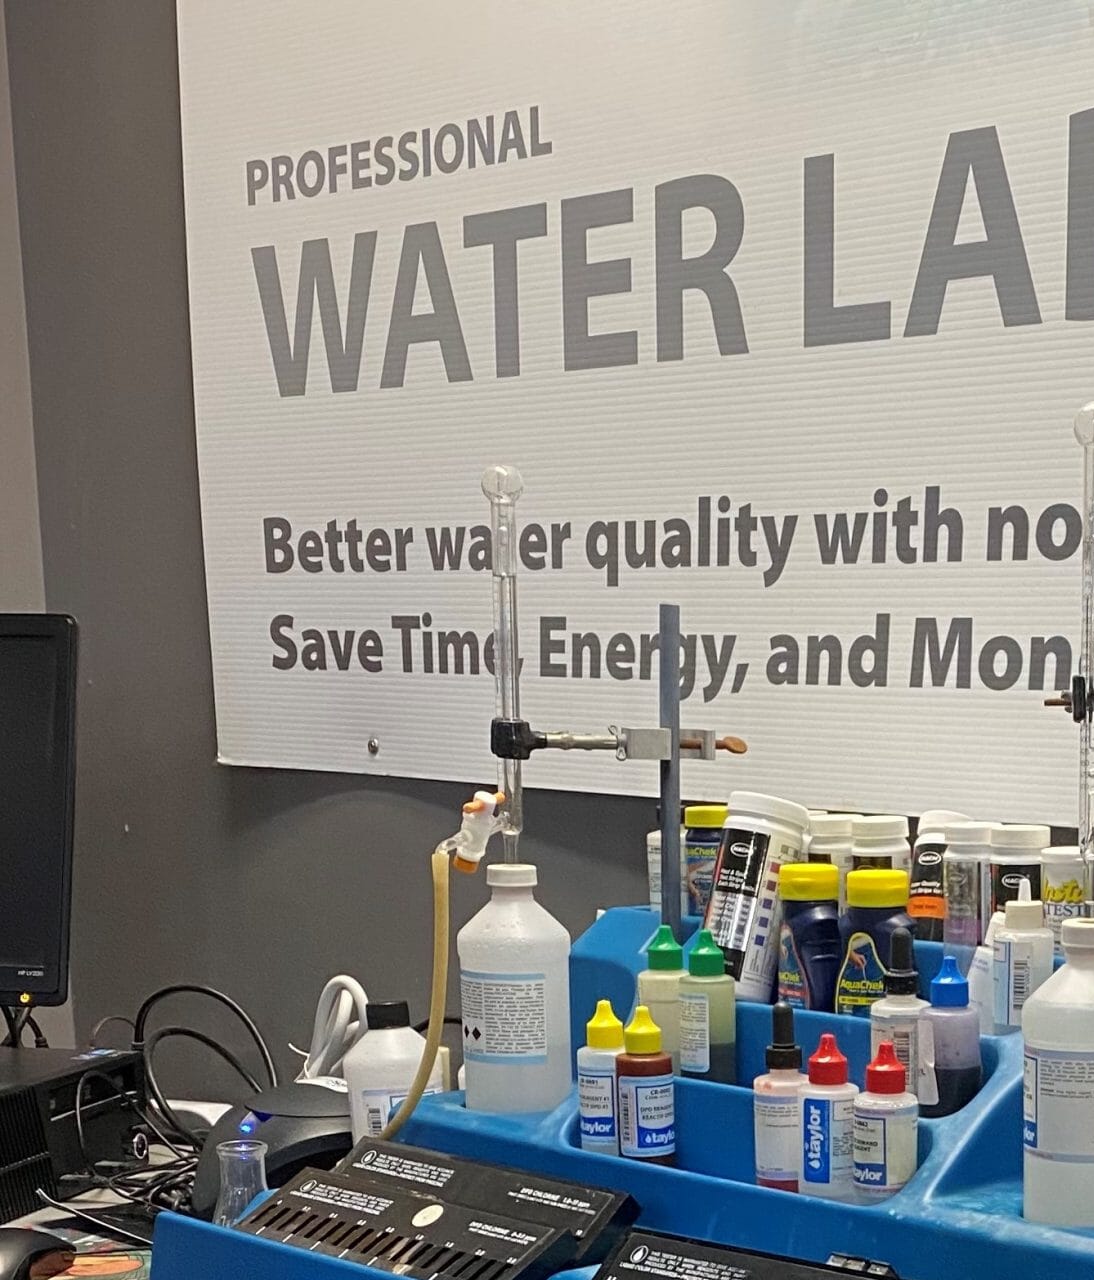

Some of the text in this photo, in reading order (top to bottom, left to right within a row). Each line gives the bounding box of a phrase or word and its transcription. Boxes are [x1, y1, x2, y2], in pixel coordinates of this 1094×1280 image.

[246, 105, 553, 206] PROFESSIONAL
[250, 173, 749, 398] WATER
[263, 516, 413, 574] Better
[425, 520, 572, 572] waer
[585, 495, 799, 588] quality
[814, 485, 964, 565] with
[986, 502, 1083, 561] no
[269, 613, 384, 673] Save
[765, 612, 891, 688] and
[840, 979, 884, 991] AquaChek
[581, 1120, 612, 1135] taylor
[651, 1128, 675, 1144] taylo
[807, 1104, 824, 1160] taylor
